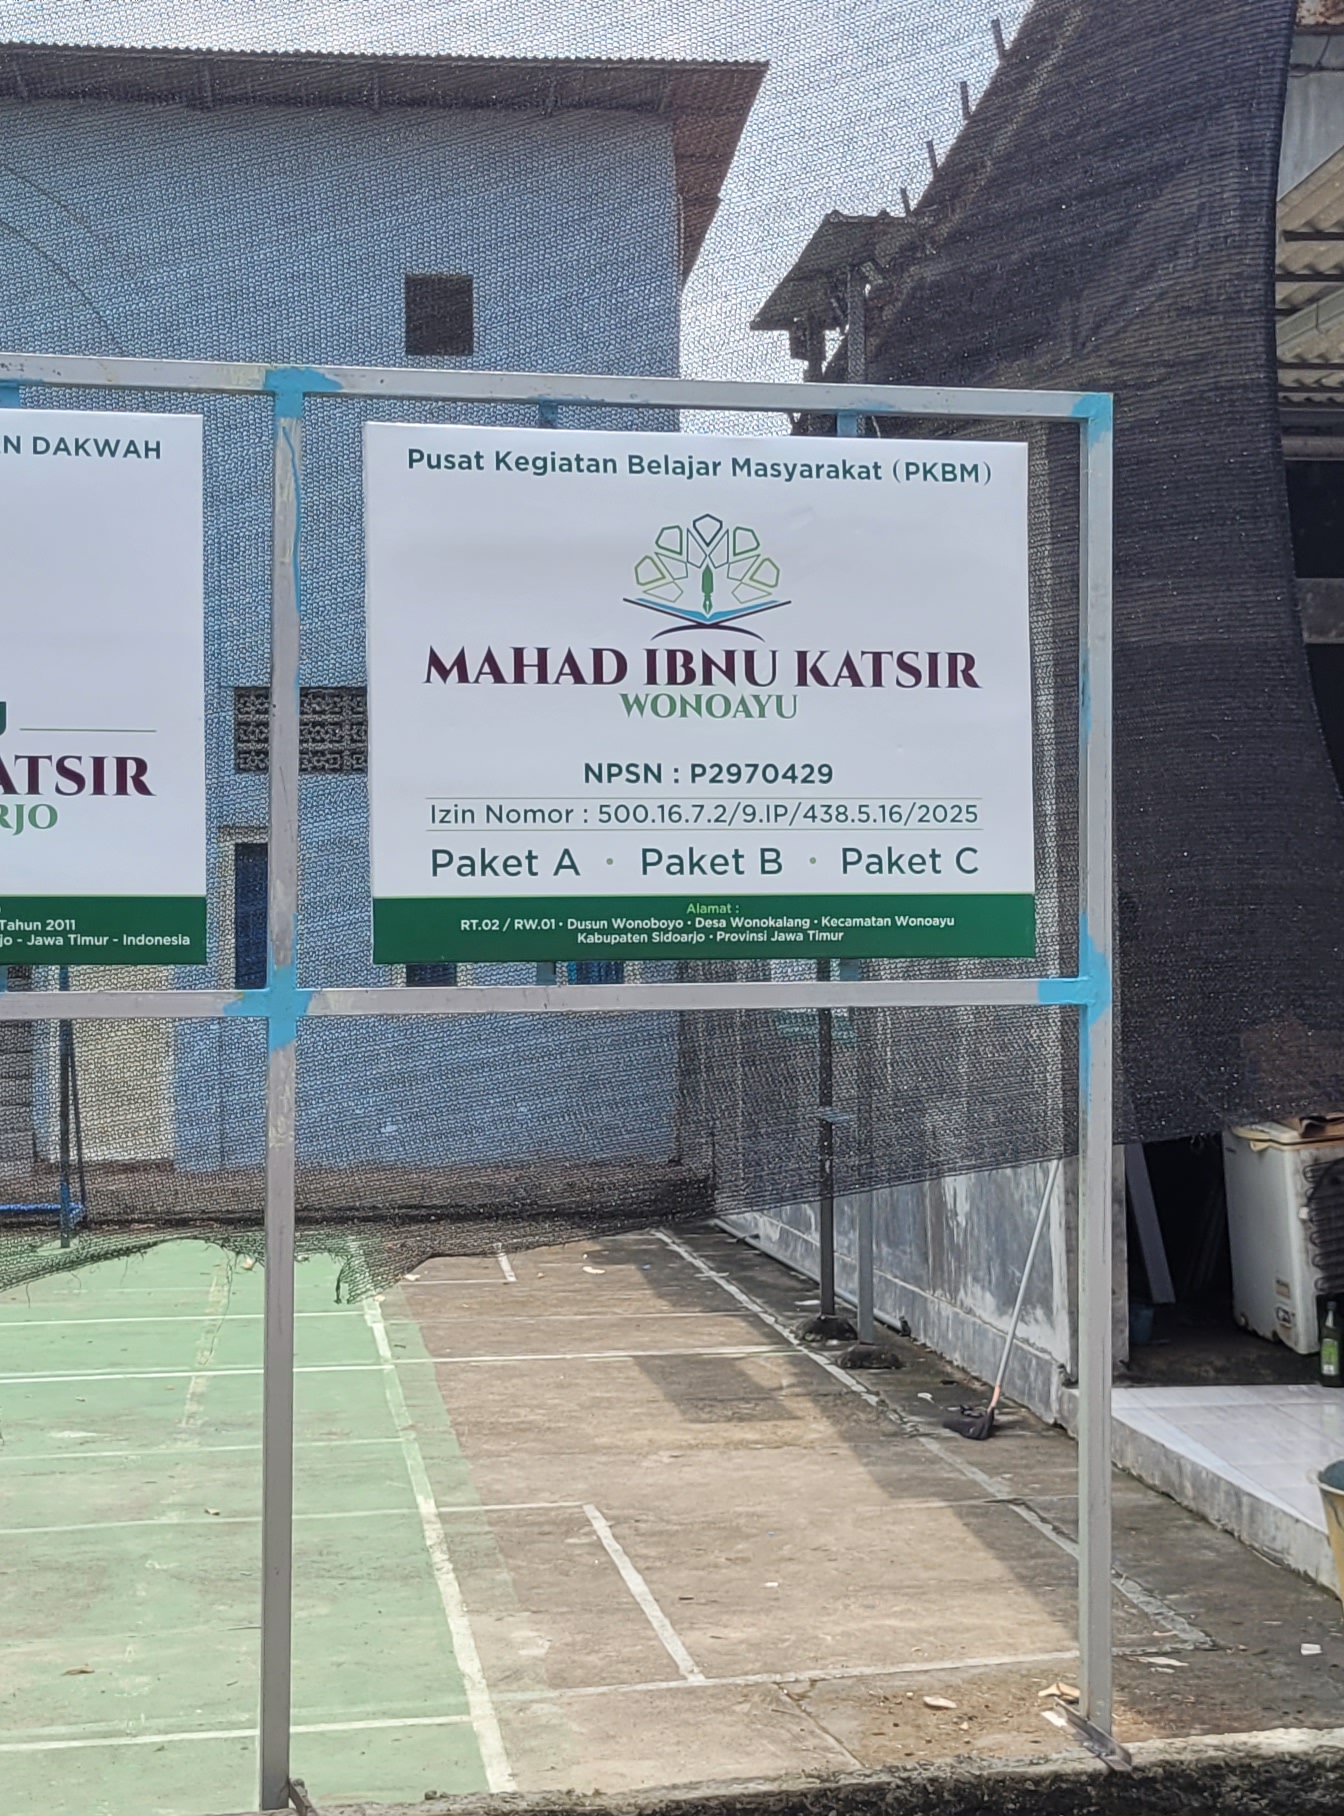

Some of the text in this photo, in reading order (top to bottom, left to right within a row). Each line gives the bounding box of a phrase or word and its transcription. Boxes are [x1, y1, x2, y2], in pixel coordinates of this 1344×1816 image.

[33, 436, 160, 459] DAKWAH
[409, 448, 991, 485] Pusat Kegiatan Belajar Masyarakat (PKBM)
[423, 646, 982, 688] MAHAD IBNU KATSIR
[620, 693, 797, 719] WONOAYU
[585, 763, 662, 783] NPSN
[691, 763, 832, 784] P2970429
[432, 804, 474, 824] Izin
[486, 805, 574, 823] Nomor
[599, 802, 977, 826] 500.16.7.2/9.IP/438.5.16/2025
[432, 846, 978, 877] Paket A Paket B Paket C
[686, 902, 732, 914] Alamat
[45, 918, 76, 931] 2011
[460, 918, 500, 931] RT.02
[514, 918, 556, 930] RW.01
[567, 918, 608, 930] Dusun
[611, 916, 684, 932] Wonoboyo
[694, 916, 727, 929] Desa
[729, 915, 811, 930] Wonokalang
[821, 915, 892, 928] Kecamatan
[894, 915, 955, 929] Wonoayu
[26, 933, 64, 946] Jawa
[67, 933, 110, 946] Timur
[122, 933, 191, 946] Indonesia
[577, 929, 845, 946] Kabupaten Sidoarjo Provinsi Jawa Timur
